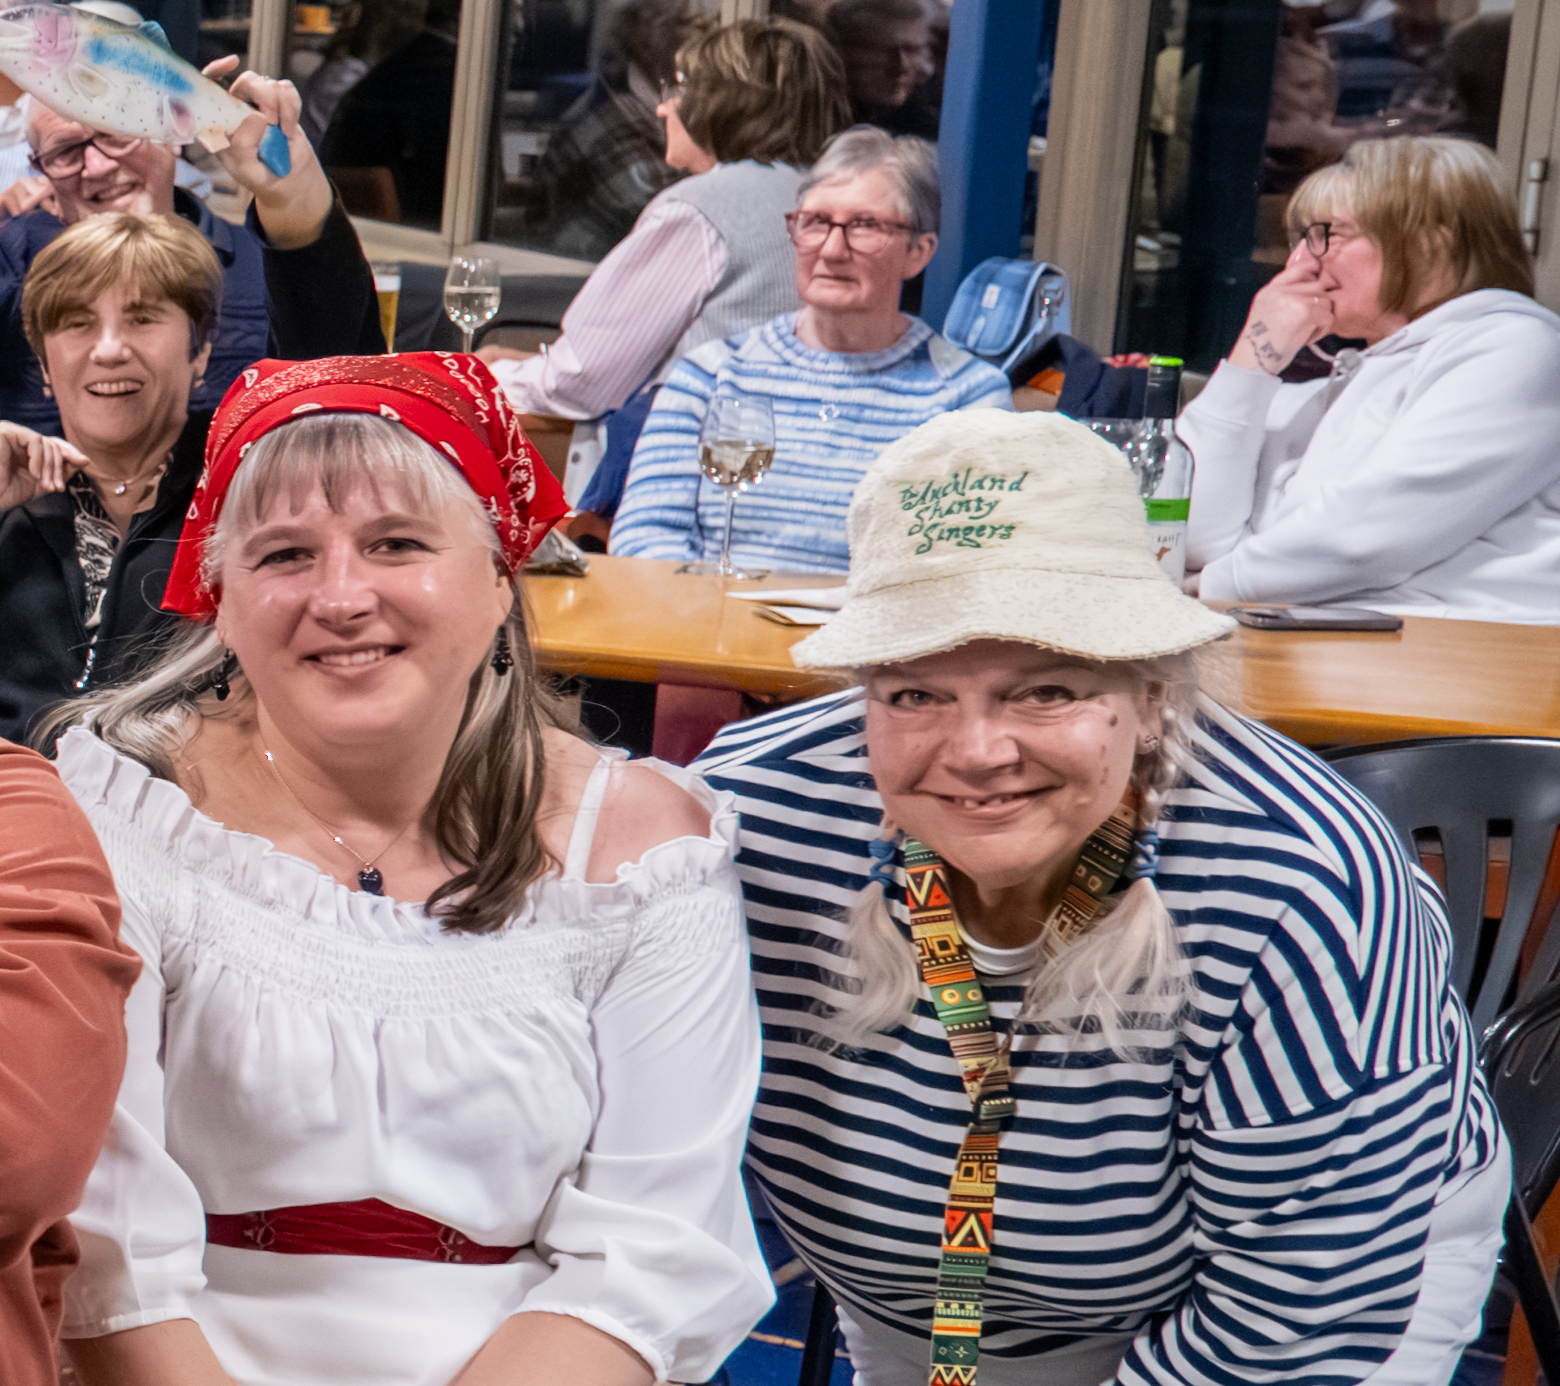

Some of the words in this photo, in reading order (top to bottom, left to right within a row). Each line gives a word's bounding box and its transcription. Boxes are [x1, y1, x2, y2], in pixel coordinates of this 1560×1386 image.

[901, 467, 1030, 511] Auckland
[907, 496, 1000, 537] Shanty
[915, 522, 1017, 555] Singers
